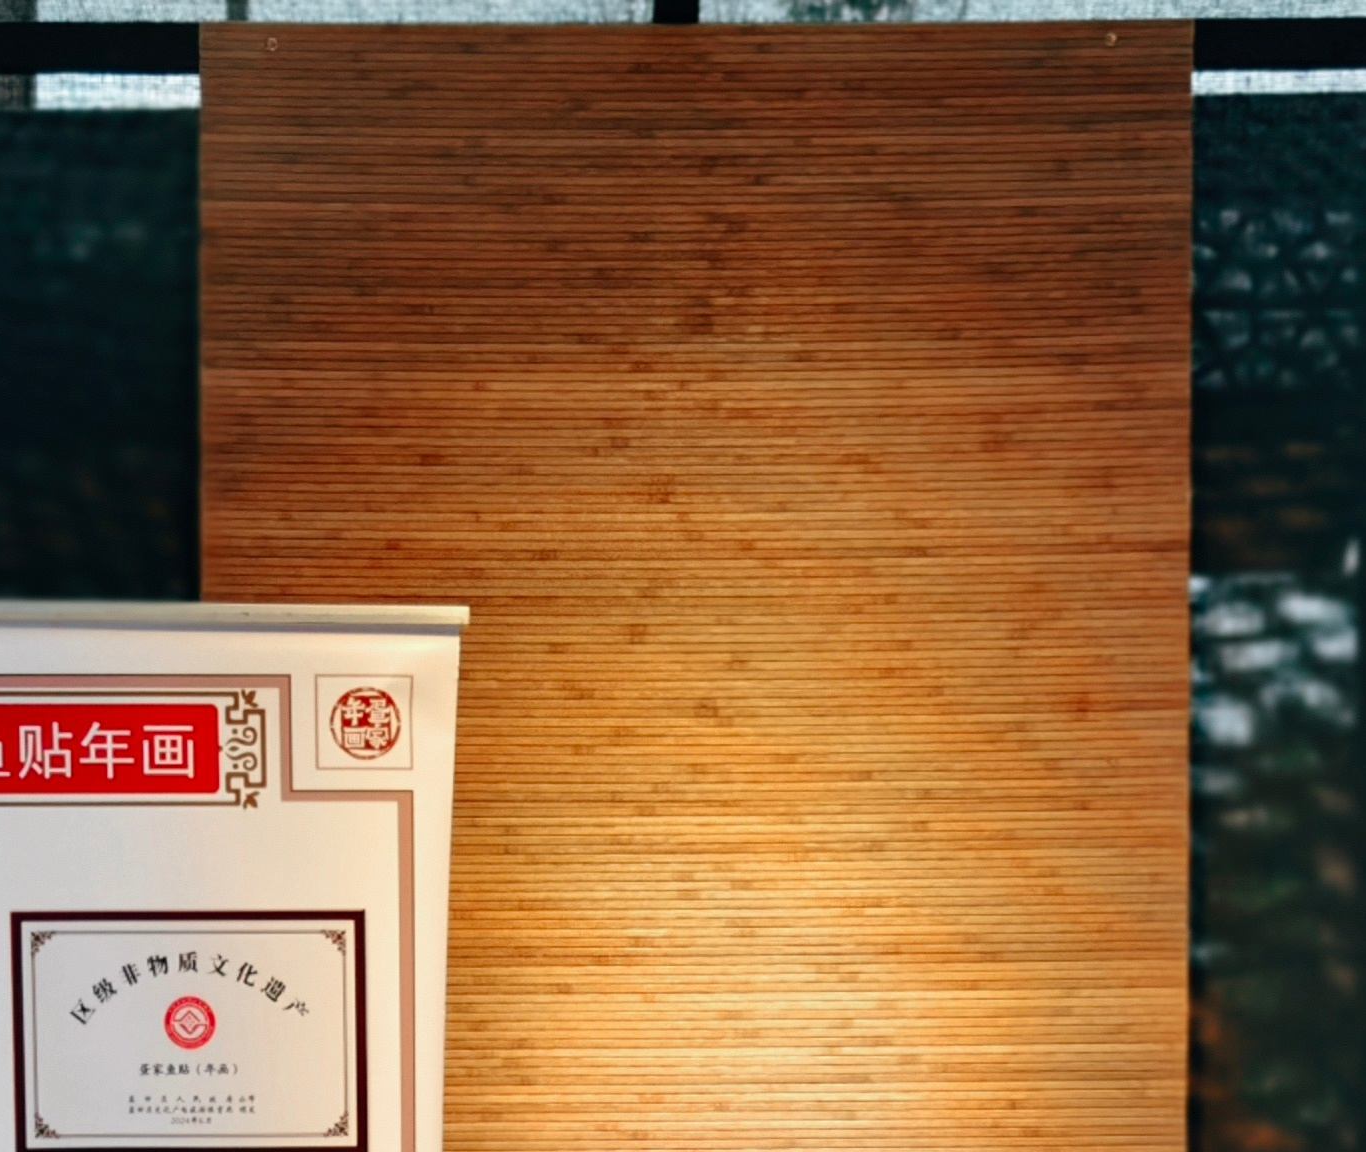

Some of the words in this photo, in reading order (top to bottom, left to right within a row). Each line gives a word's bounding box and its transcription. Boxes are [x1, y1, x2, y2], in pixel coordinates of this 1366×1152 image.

[70, 951, 310, 1025] 区级非物质文化遗产
